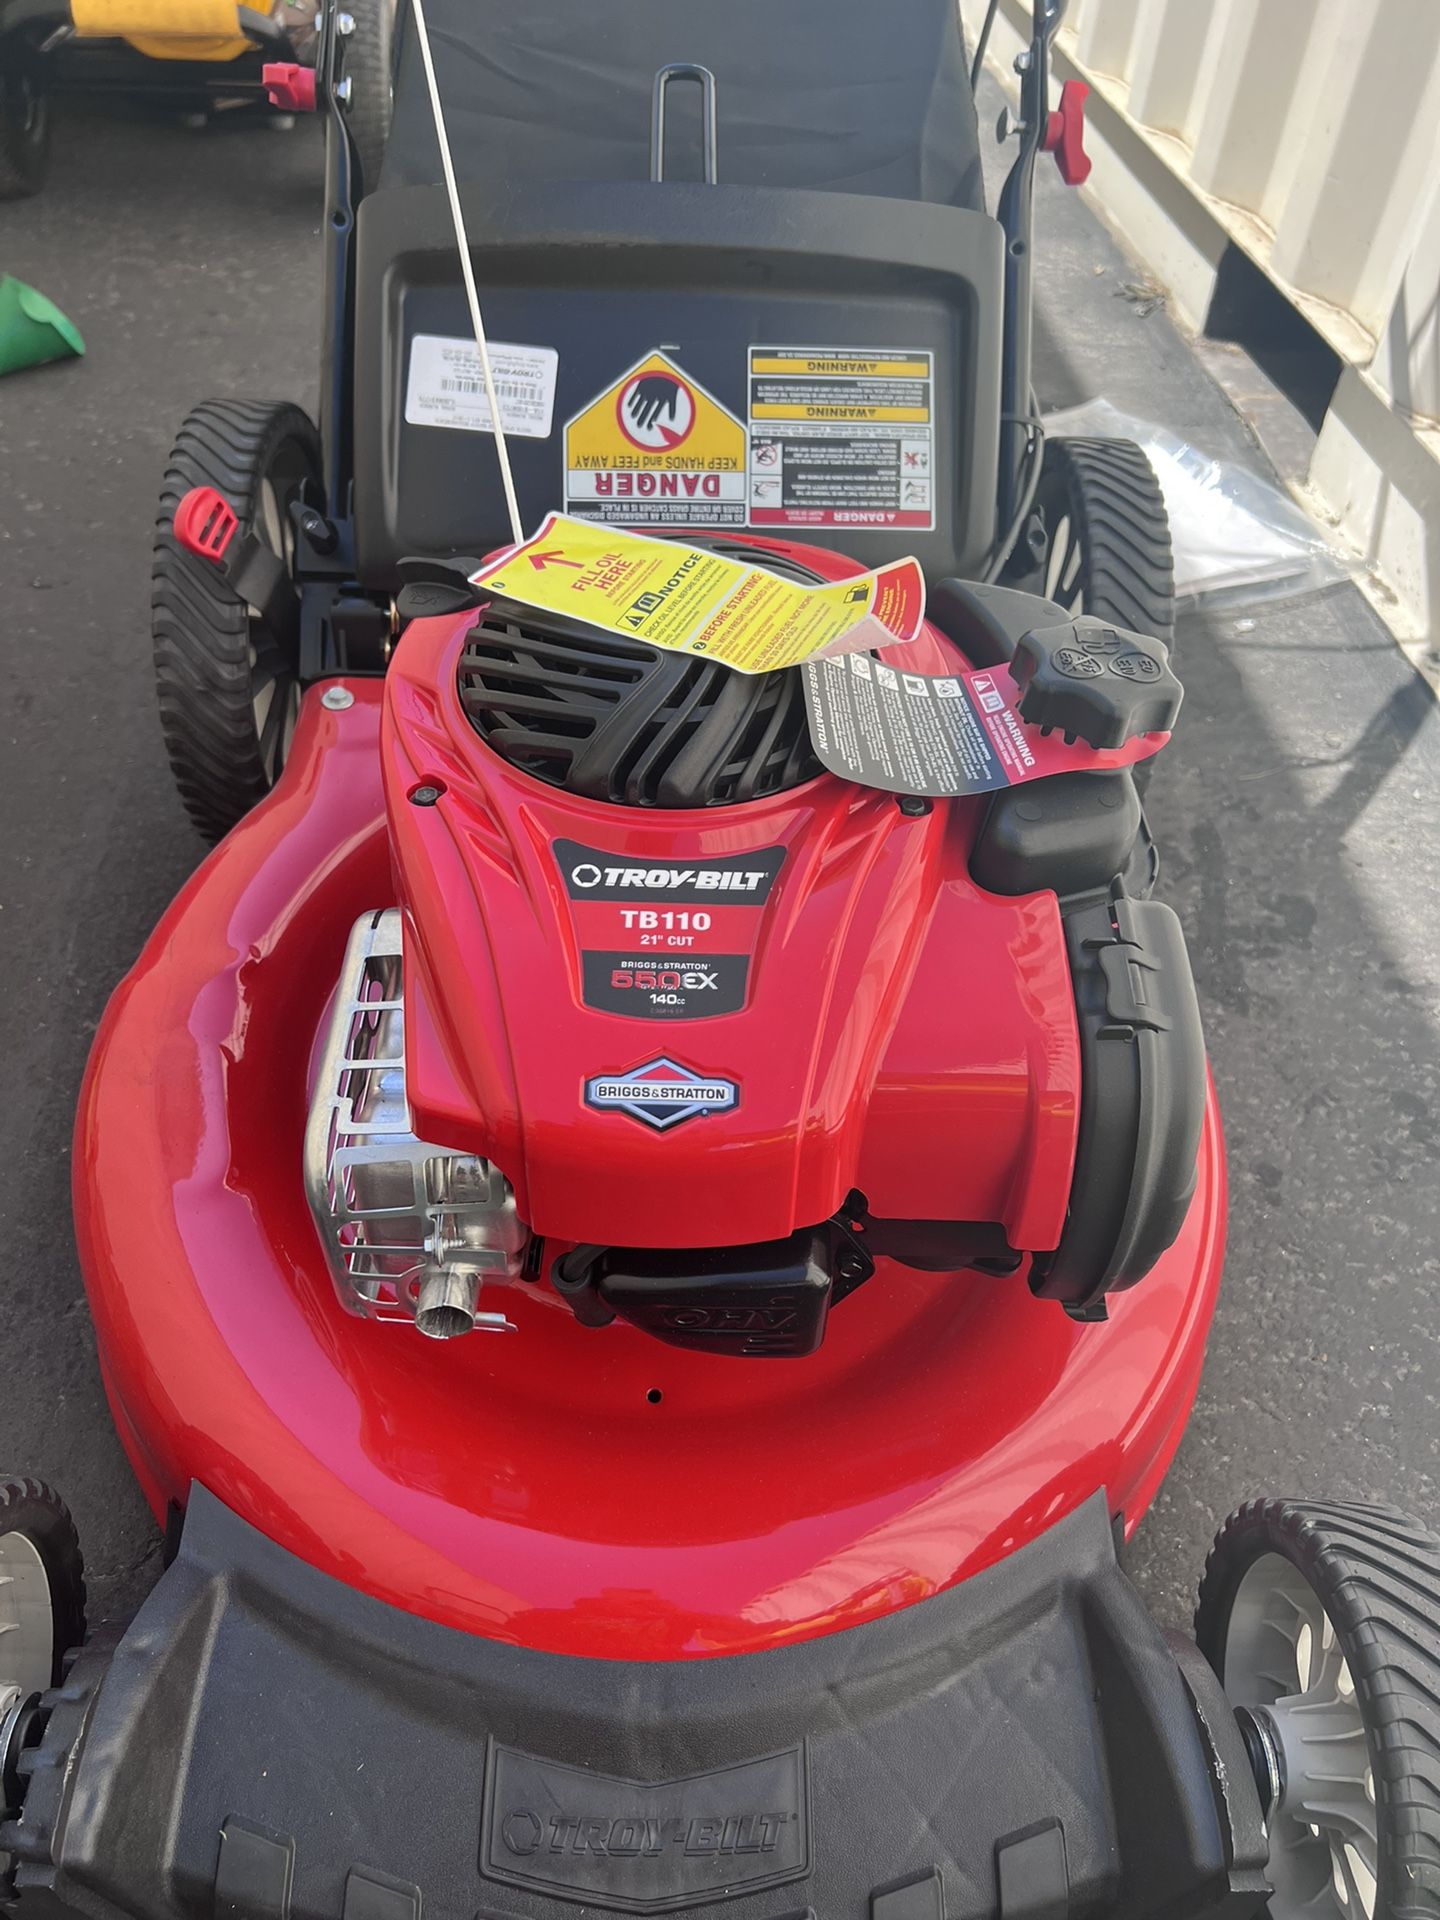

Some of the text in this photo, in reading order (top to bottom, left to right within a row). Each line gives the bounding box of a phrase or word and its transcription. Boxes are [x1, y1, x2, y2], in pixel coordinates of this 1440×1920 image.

[807, 362, 867, 372] WARNING
[806, 407, 867, 417] WARNING
[575, 456, 737, 470] KEEP HANDS and FEET AWAY
[595, 472, 720, 497] DANGER
[833, 512, 885, 522] DANGER
[571, 553, 623, 591] FILL OIL
[594, 559, 632, 590] HERE
[658, 553, 702, 596] NOTICE
[644, 622, 659, 637] CHECK
[666, 598, 681, 612] LEVEL
[701, 609, 730, 642] BEFORE
[727, 573, 763, 610] STARTING:
[1001, 711, 1035, 767] WARNING
[604, 868, 764, 890] TROY-BILT
[620, 910, 711, 931] TB110
[640, 934, 694, 947] 21" CUT
[621, 961, 708, 970] BRIGGS&STRATTON
[598, 1087, 725, 1100] BRIGGS&STRATTON
[549, 1813, 788, 1857] TROY-BILT
